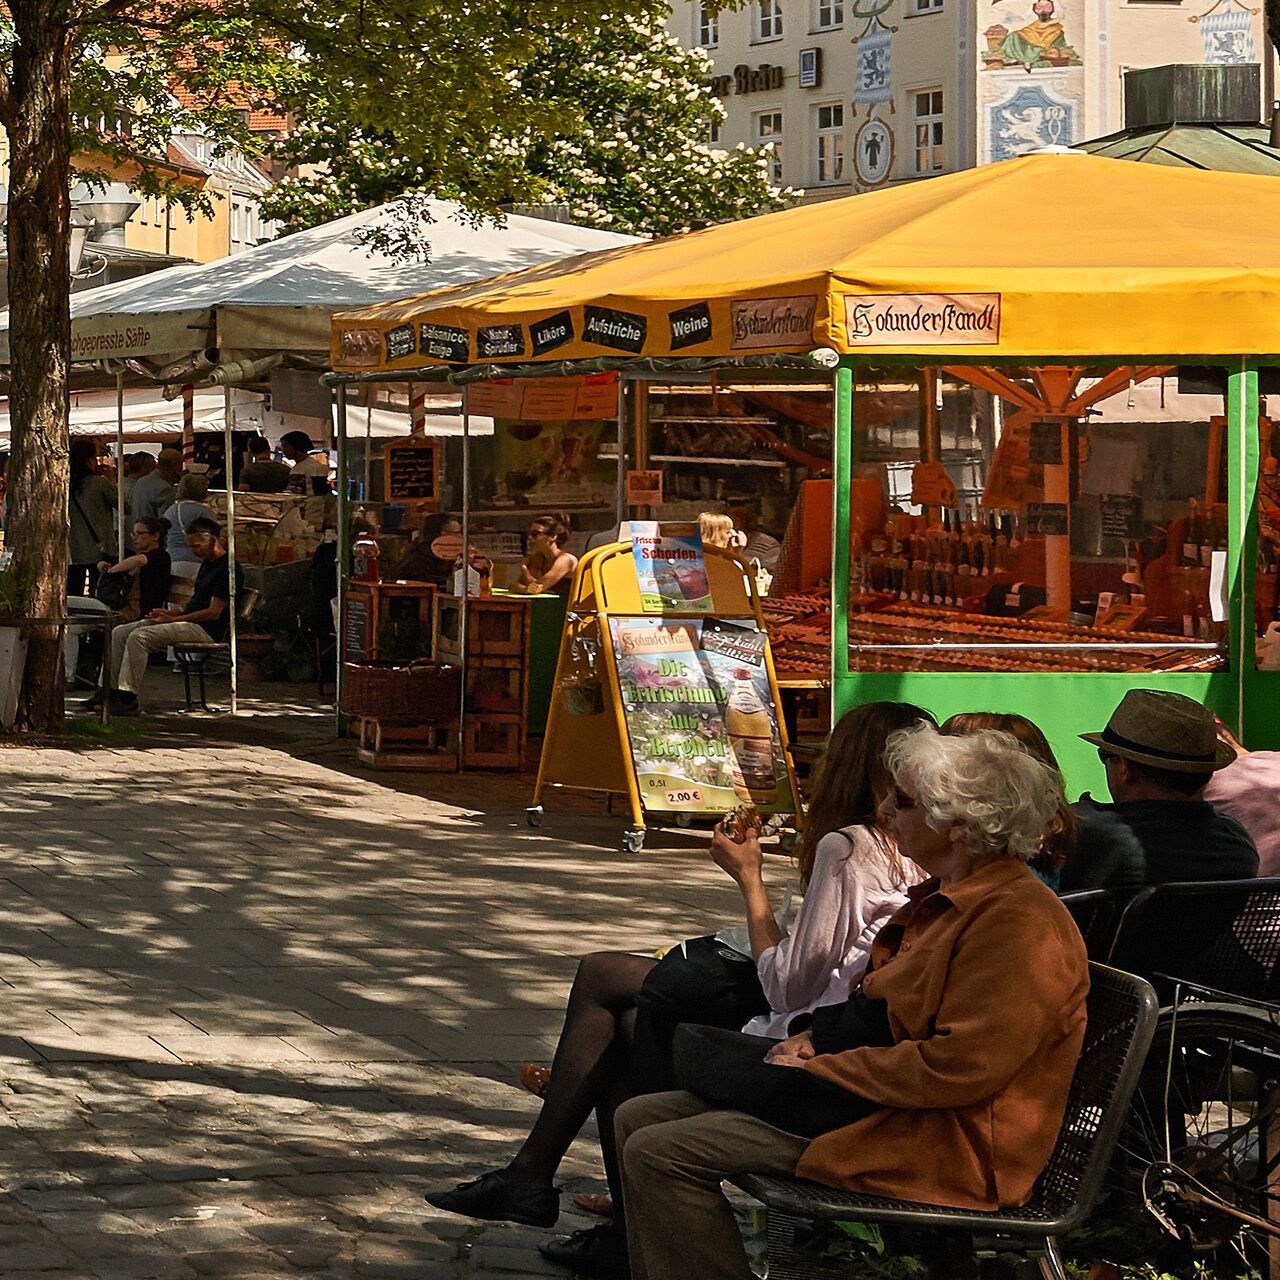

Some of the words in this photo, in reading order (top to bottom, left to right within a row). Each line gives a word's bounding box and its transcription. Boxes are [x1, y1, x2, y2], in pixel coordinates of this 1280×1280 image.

[537, 324, 566, 345] Liköre
[588, 317, 642, 341] Aufstriche
[672, 315, 709, 337] Weine
[72, 330, 124, 356] chgepresste
[125, 326, 151, 348] Säfte
[642, 547, 697, 560] Schorlen
[657, 658, 688, 678] Die
